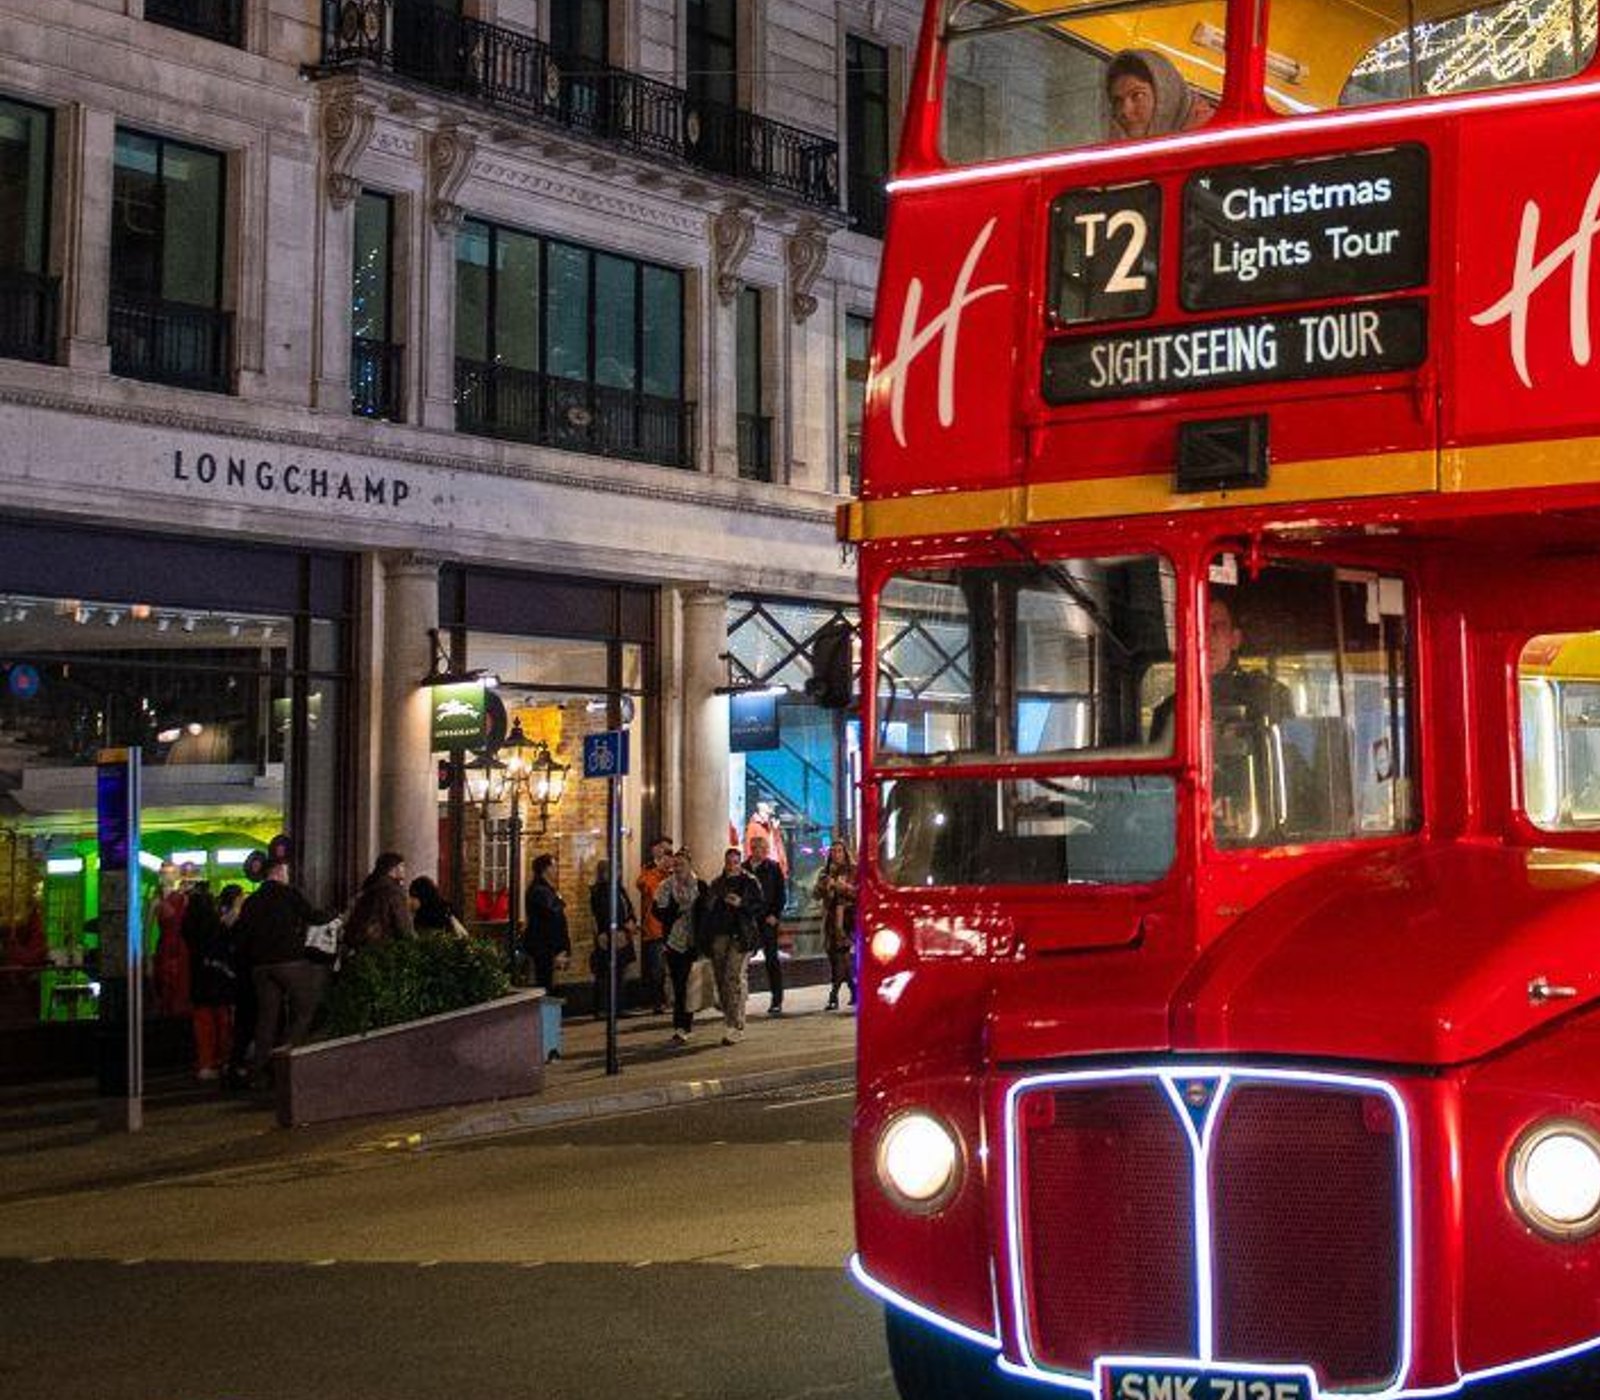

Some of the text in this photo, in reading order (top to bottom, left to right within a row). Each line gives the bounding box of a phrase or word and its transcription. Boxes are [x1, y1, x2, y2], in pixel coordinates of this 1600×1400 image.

[1222, 176, 1392, 222] Christmas
[1075, 209, 1148, 294] T2
[1212, 226, 1400, 281] Lights Tour
[874, 217, 1008, 448] H
[1090, 310, 1383, 388] SIGHTSEEING TOUR
[174, 450, 410, 507] LONGCHAMP
[1121, 1373, 1199, 1399] SMK
